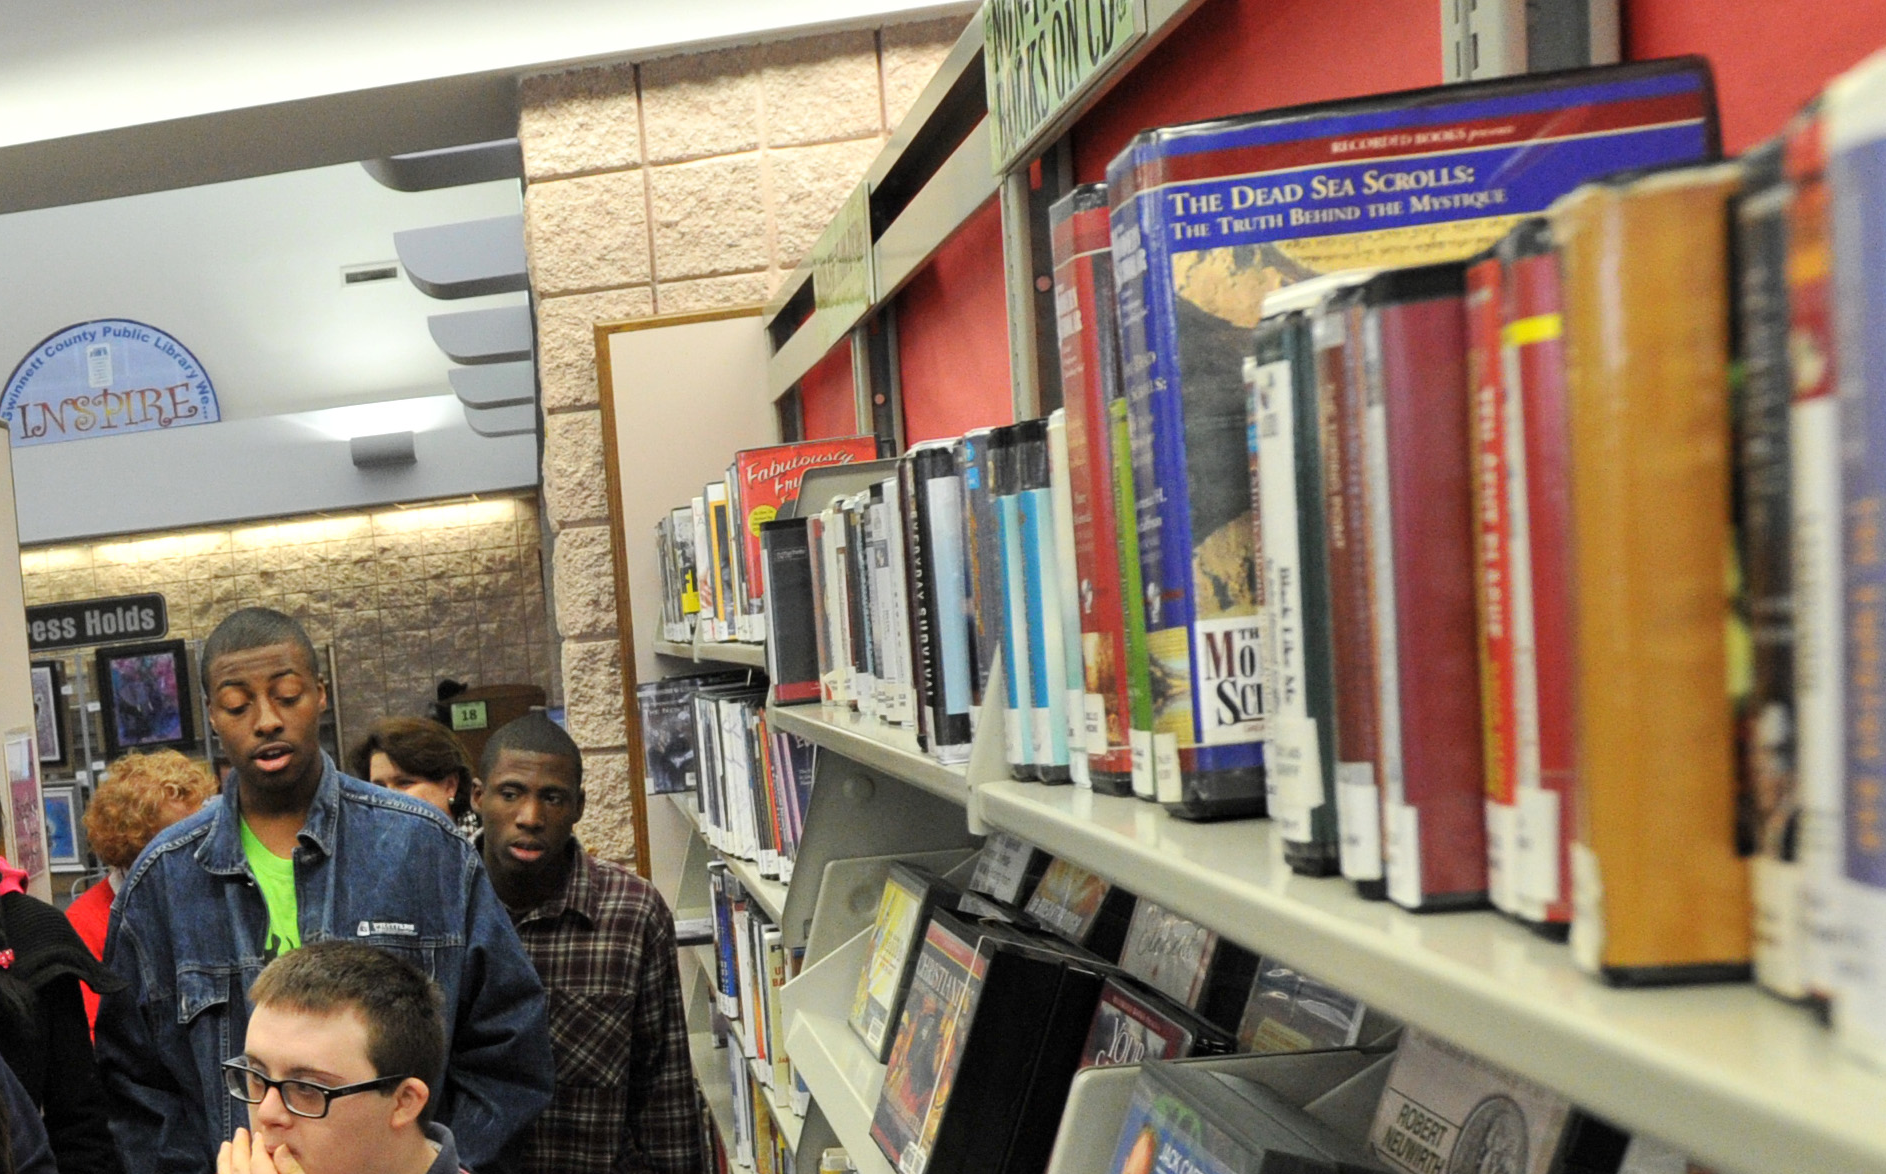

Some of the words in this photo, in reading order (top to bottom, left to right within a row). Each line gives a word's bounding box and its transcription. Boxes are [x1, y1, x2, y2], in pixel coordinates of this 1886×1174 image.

[1415, 128, 1466, 145] BOOKS
[1168, 193, 1222, 217] THE
[1231, 184, 1303, 211] DEAD
[1311, 175, 1355, 200] SEA
[1363, 165, 1475, 192] SCROLLS:
[1170, 221, 1211, 240] THE
[1217, 213, 1283, 235] TRUTH
[1289, 205, 1361, 226] BEHIND
[1367, 200, 1404, 219] THE
[1410, 188, 1507, 214] MYSTIQUE
[1, 357, 45, 422] Gwinnett
[44, 330, 97, 358] County
[102, 325, 151, 344] Public
[153, 336, 199, 380] Library
[17, 382, 198, 440] INSPIRE
[746, 449, 856, 489] Fabulously
[29, 616, 77, 642] ess
[84, 605, 156, 636] Holds
[460, 709, 479, 723] 18
[1395, 1103, 1448, 1149] ROBERT
[1158, 1142, 1183, 1173] JACK
